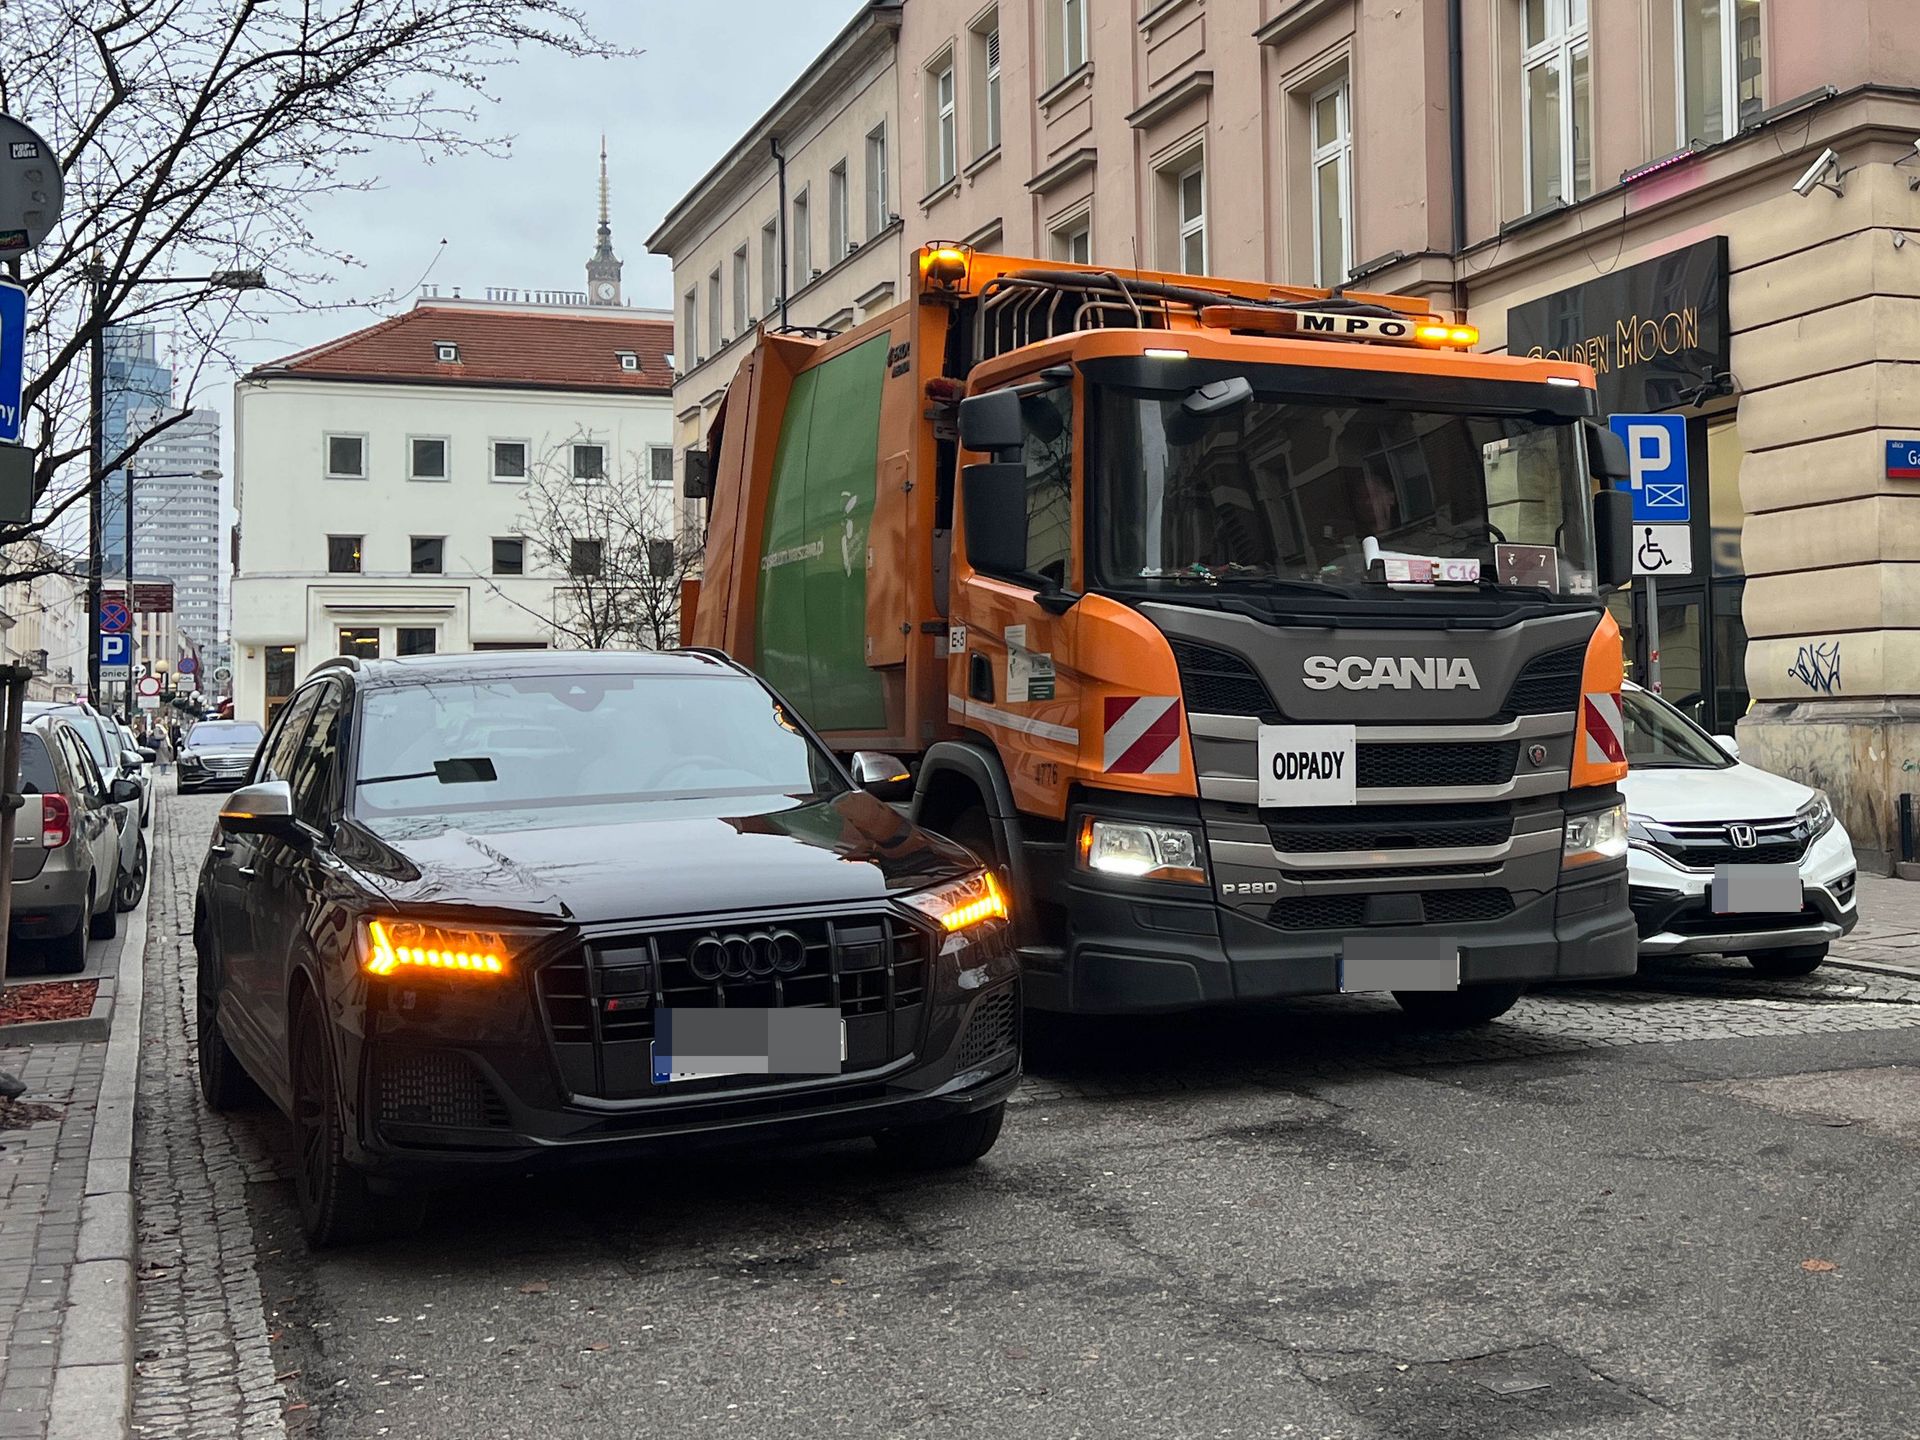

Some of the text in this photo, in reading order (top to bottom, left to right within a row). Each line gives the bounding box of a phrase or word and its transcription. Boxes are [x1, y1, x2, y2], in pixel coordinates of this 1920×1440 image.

[1302, 315, 1407, 337] MPO
[1616, 307, 1698, 369] MOON
[1628, 424, 1672, 490] P
[1446, 565, 1478, 580] C16
[102, 636, 123, 661] P
[100, 669, 127, 678] oniec
[1302, 655, 1481, 691] SCANIA
[1272, 751, 1345, 781] ODPADY
